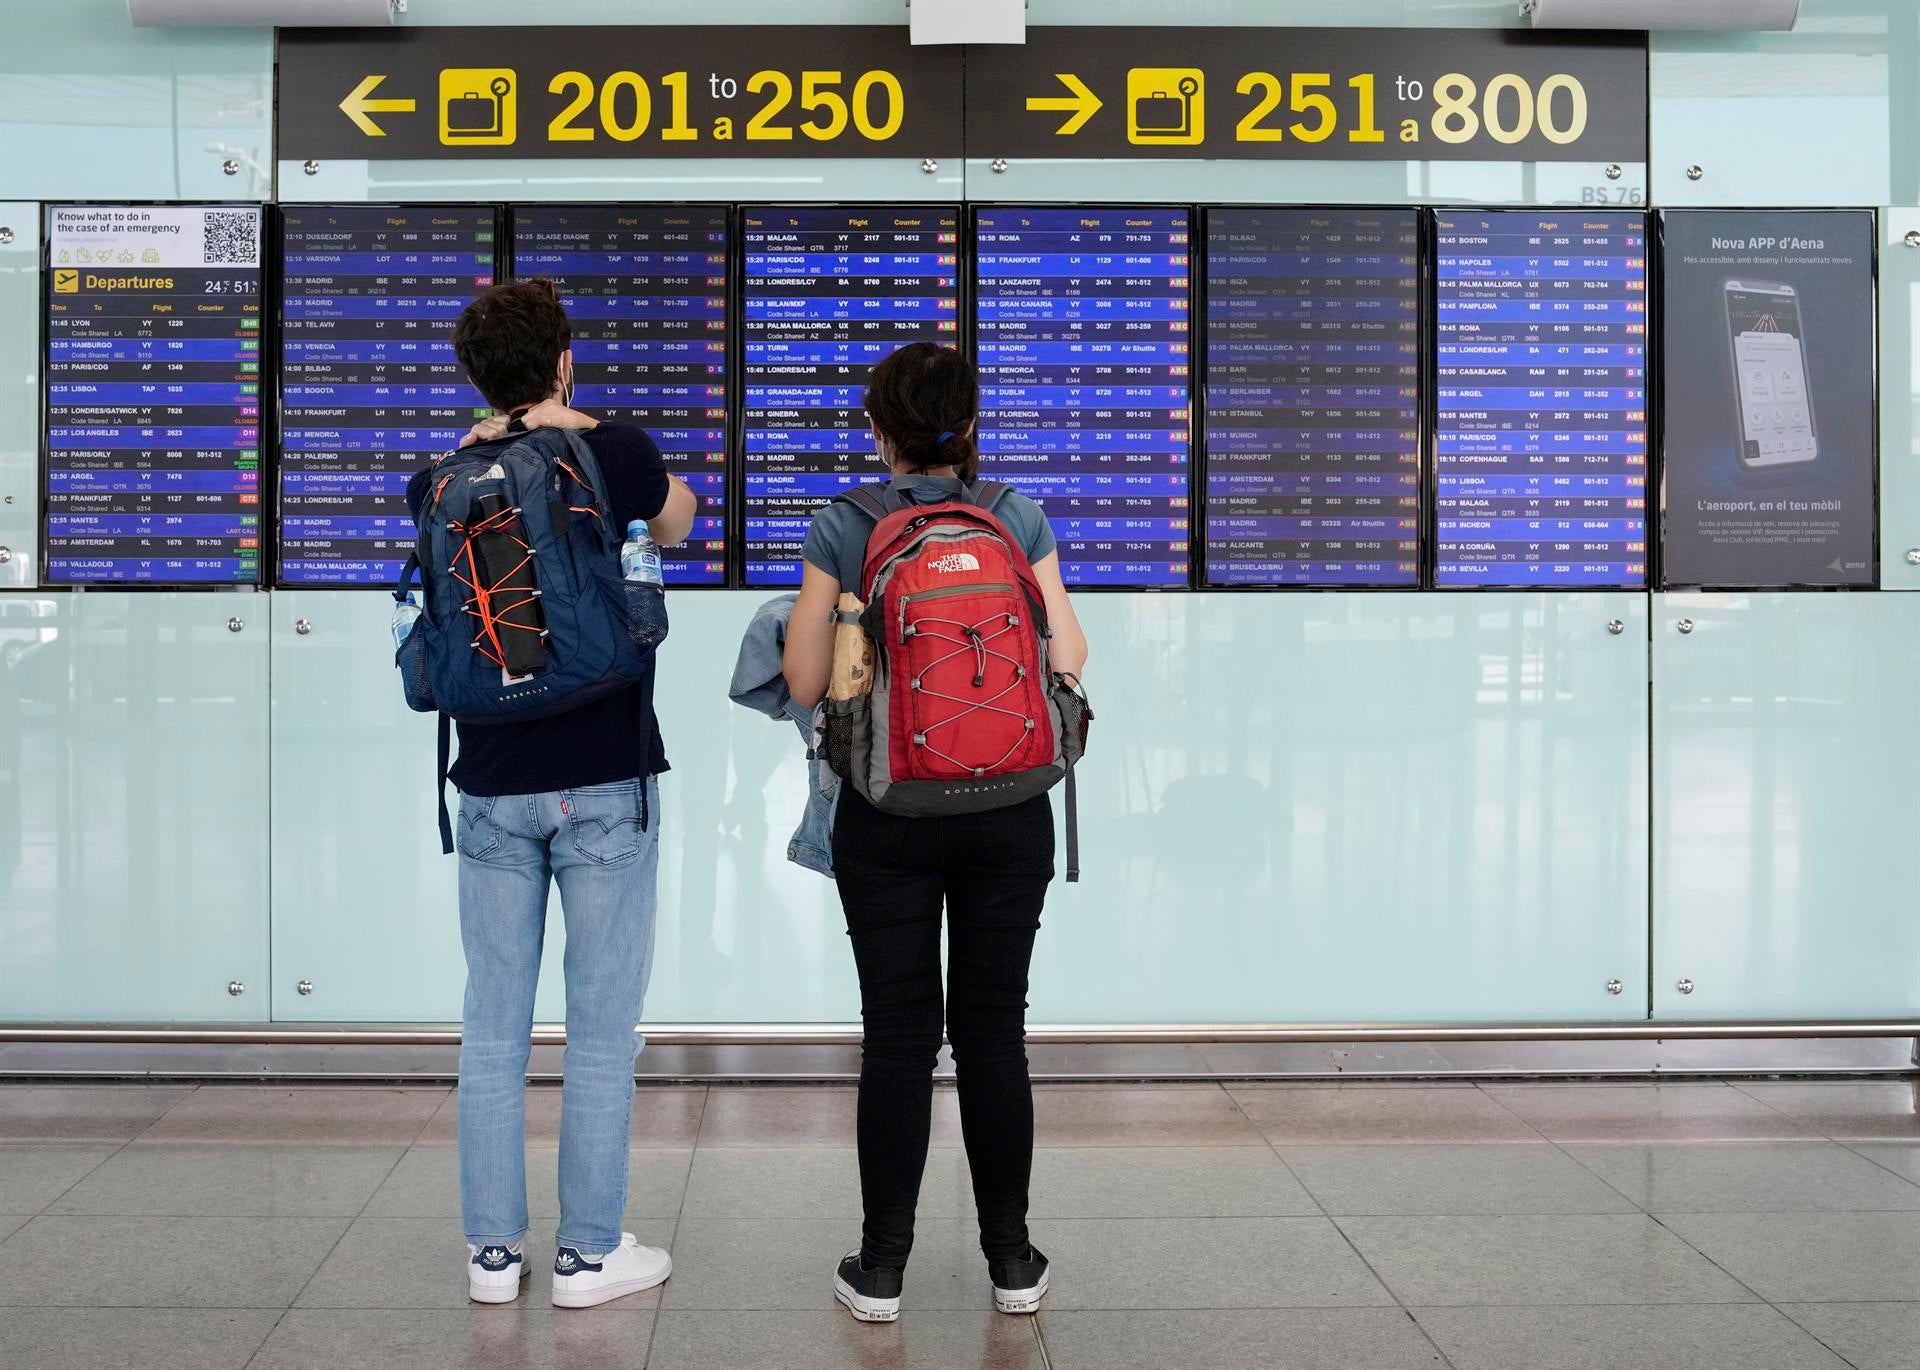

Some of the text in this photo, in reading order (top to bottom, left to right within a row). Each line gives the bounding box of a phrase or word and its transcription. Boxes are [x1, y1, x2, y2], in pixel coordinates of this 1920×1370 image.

[548, 70, 904, 141] 201 to a 250
[1236, 72, 1587, 144] 251 to a 800
[1582, 186, 1641, 204] BS 76
[57, 212, 150, 221] Know what to do in
[57, 223, 74, 232] the
[100, 223, 110, 232] of
[126, 225, 180, 234] emergency
[1712, 237, 1745, 249] Nova
[1748, 237, 1776, 249] APP
[1699, 256, 1735, 264] accessible,
[1736, 256, 1752, 264] amb
[1753, 256, 1779, 265] disseny
[1784, 256, 1831, 264] funcionalitats
[86, 275, 174, 292] Departures
[152, 304, 172, 312] Flight
[1759, 502, 1773, 510] en
[1776, 500, 1786, 511] el
[1789, 501, 1808, 511] teu
[1811, 500, 1841, 510] mòbil
[928, 558, 962, 570] NORTH
[940, 554, 961, 562] THE
[938, 566, 964, 574] FACE
[499, 686, 549, 701] BOREALIS
[944, 782, 1015, 795] BOREALIS
